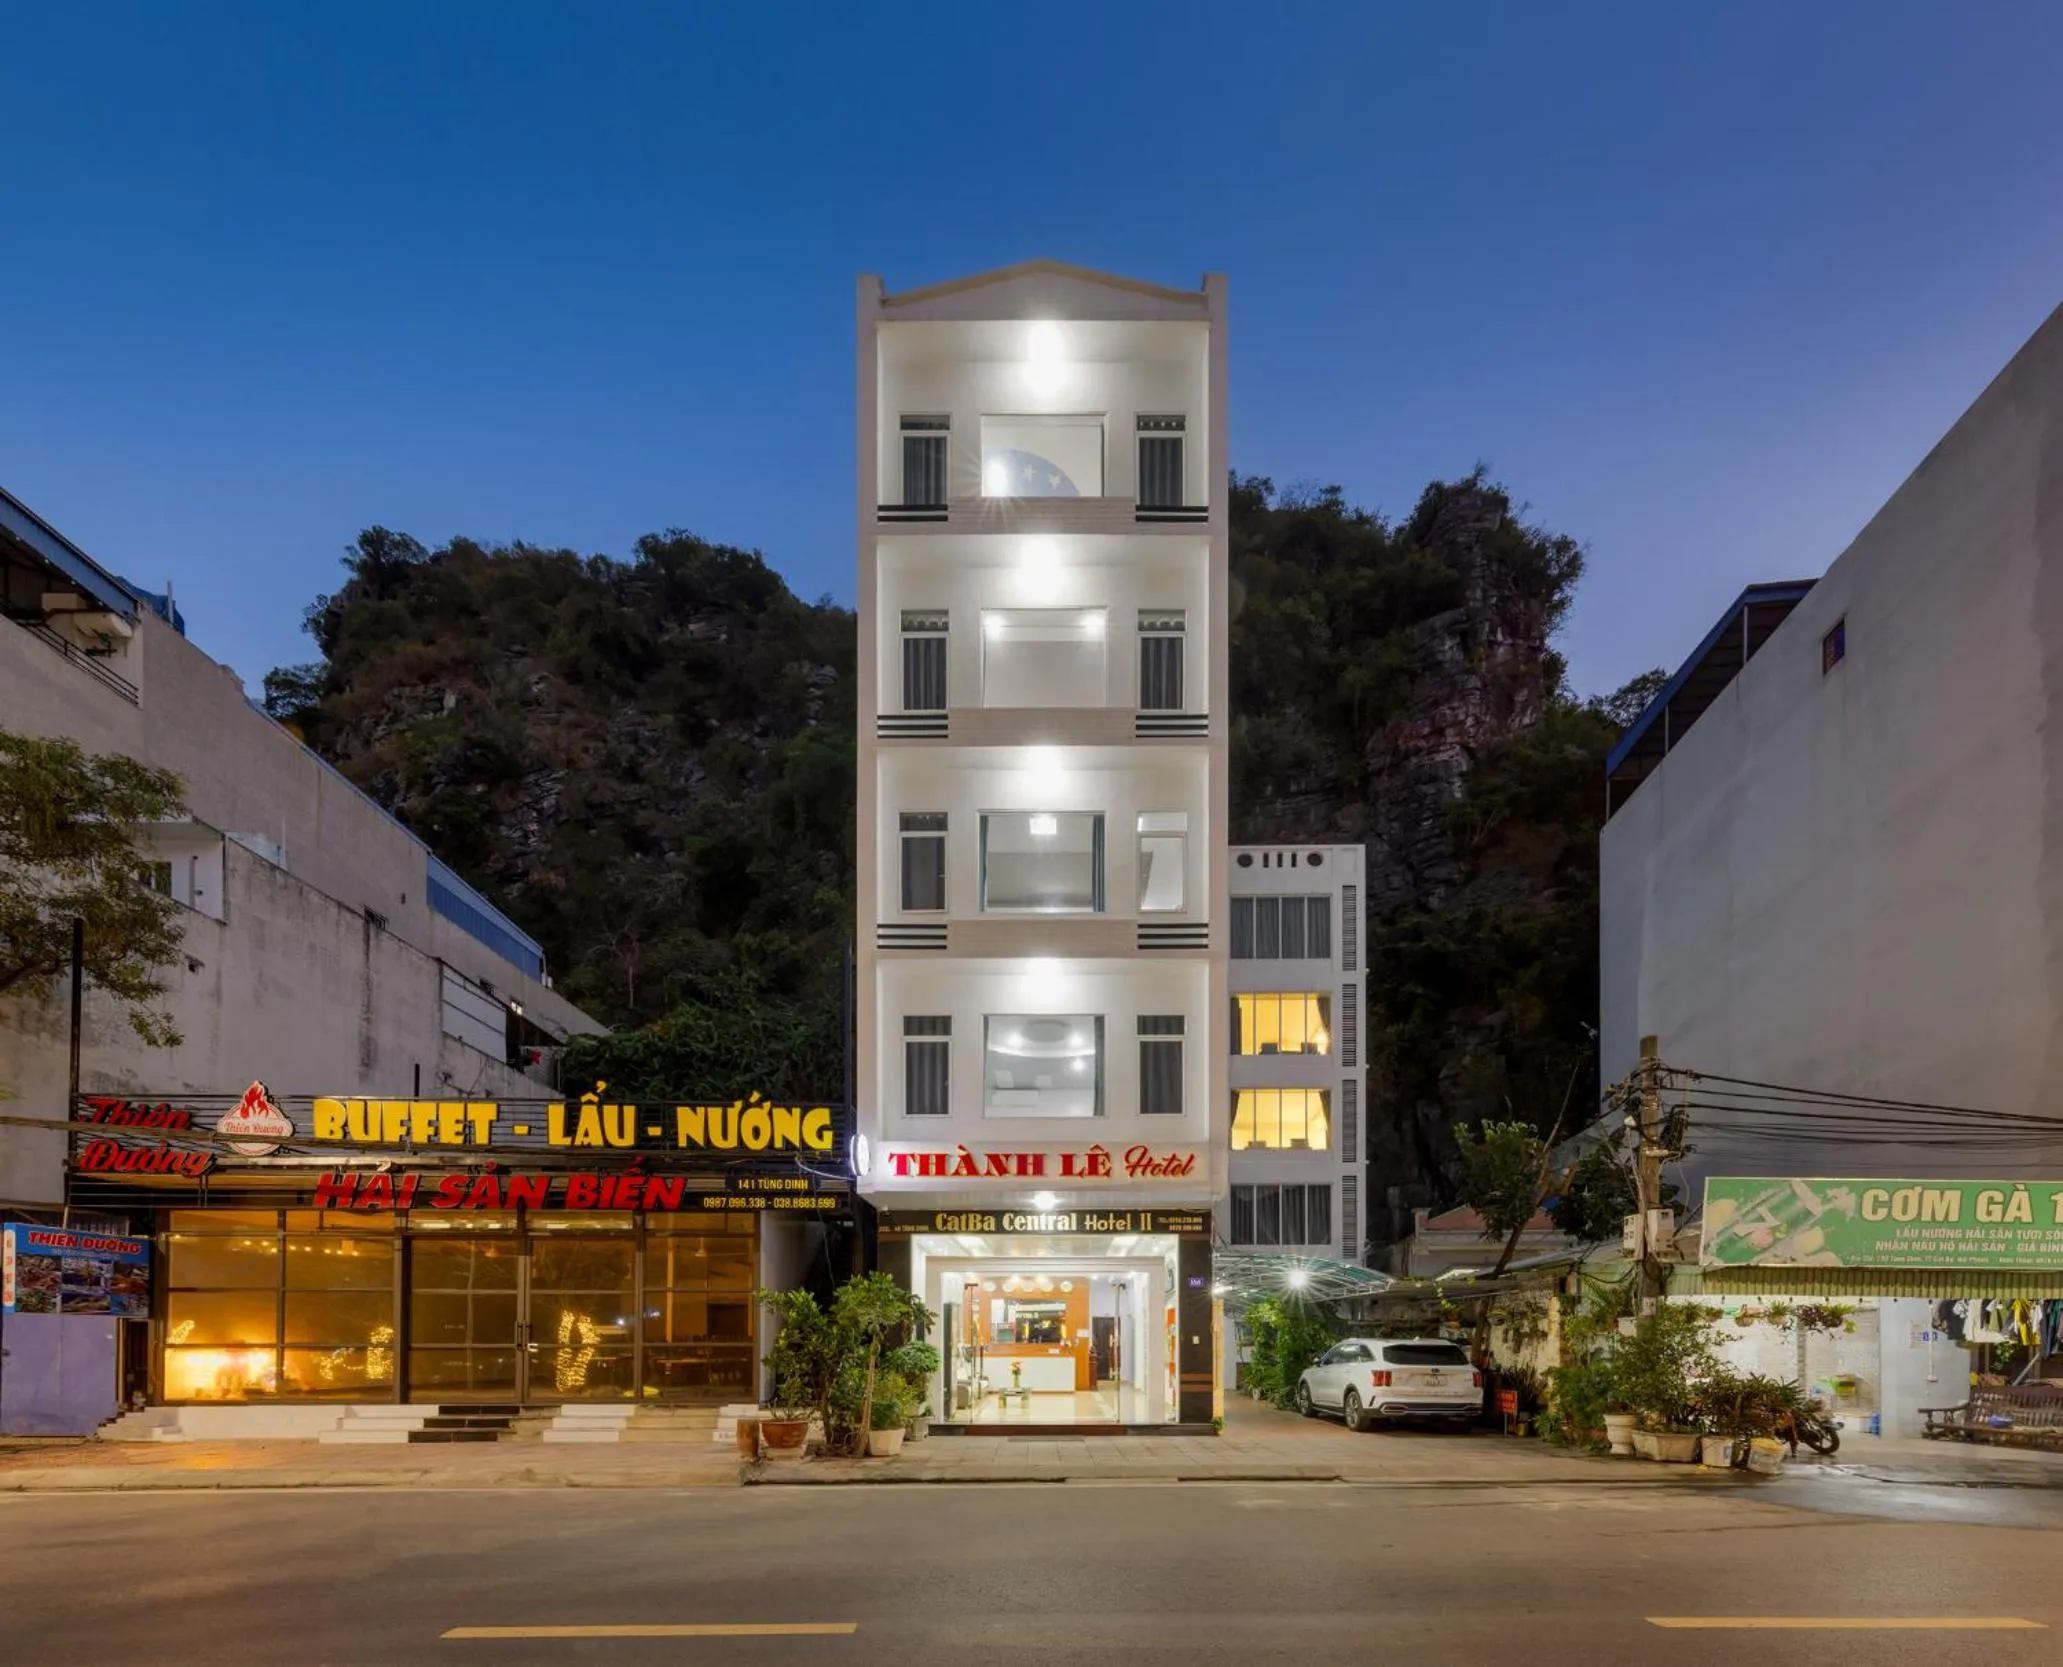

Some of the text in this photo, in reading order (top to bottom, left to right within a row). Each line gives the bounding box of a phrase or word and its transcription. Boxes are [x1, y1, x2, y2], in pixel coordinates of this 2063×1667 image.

[313, 1099, 498, 1146] BUFFET
[547, 1079, 636, 1147] LẨU
[676, 1090, 834, 1151] NƯỚNG
[888, 1144, 1196, 1179] THÀNH LÊ Hotel
[313, 1157, 420, 1209] HẢI
[1861, 1186, 1962, 1223] CƠM
[1975, 1183, 2034, 1224] GÀ
[935, 1212, 996, 1232] CatBa
[1002, 1212, 1077, 1232] Central
[1084, 1214, 1132, 1232] Hotel
